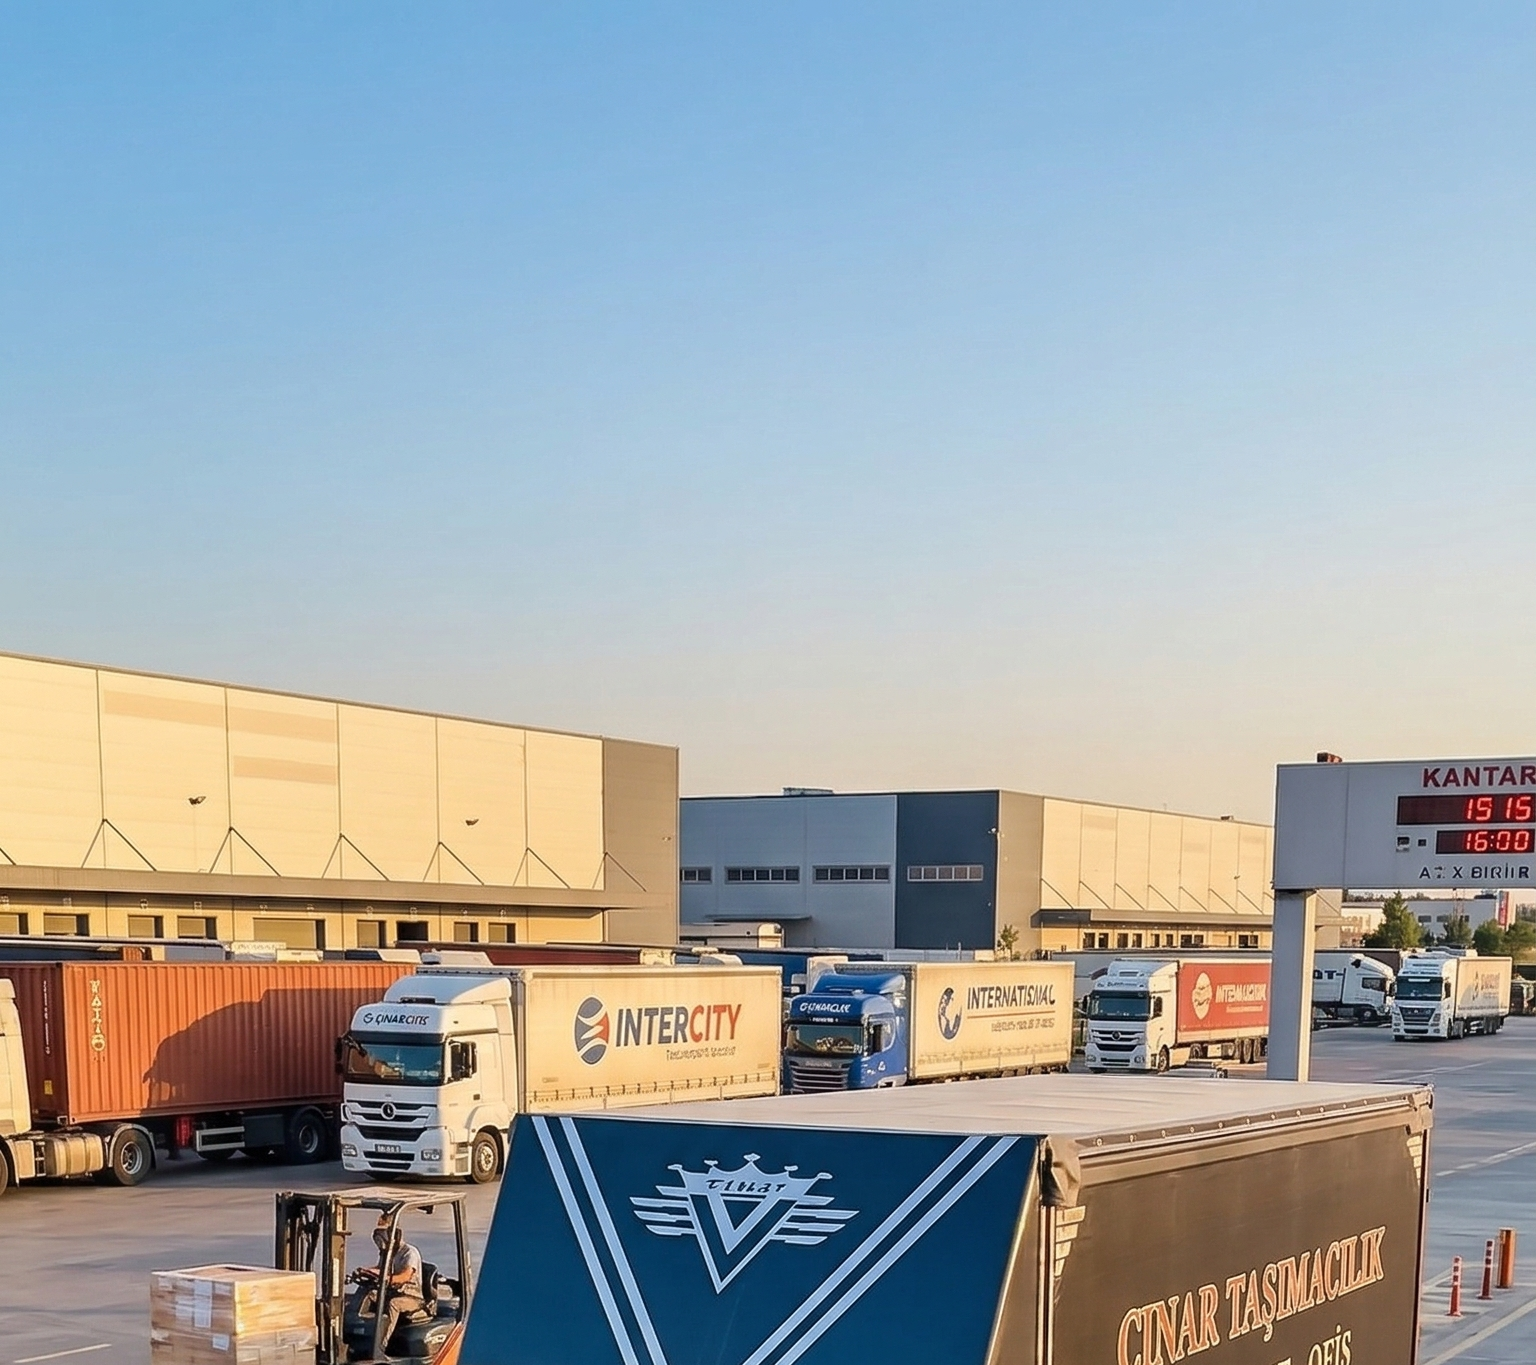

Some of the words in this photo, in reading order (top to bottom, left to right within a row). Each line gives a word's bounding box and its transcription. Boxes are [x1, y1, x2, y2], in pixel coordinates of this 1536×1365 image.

[1466, 831, 1530, 851] 16:00
[616, 1003, 742, 1047] INTERCITY
[1225, 1225, 1387, 1343] TAŞIMACILIK
